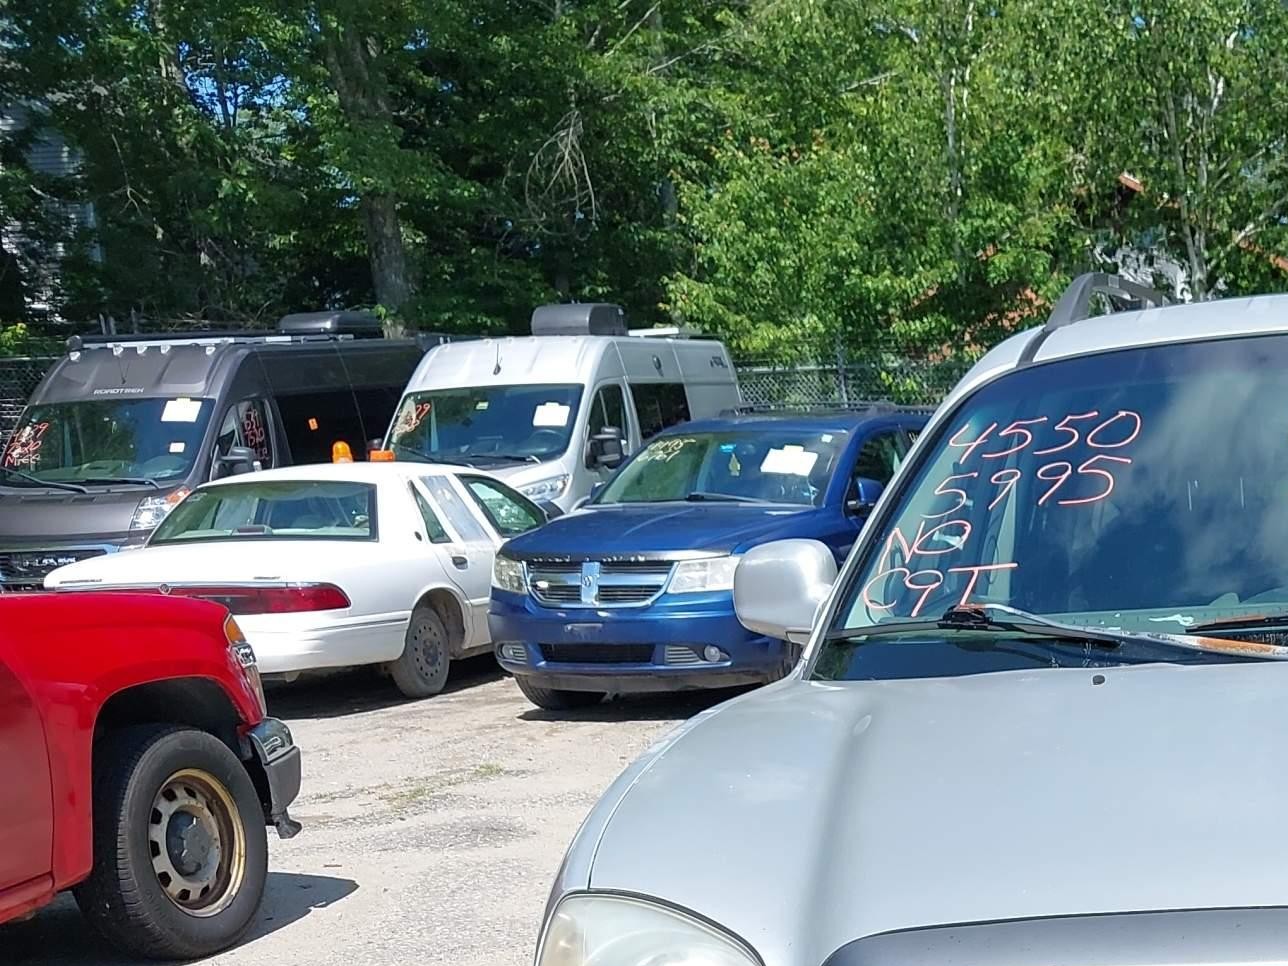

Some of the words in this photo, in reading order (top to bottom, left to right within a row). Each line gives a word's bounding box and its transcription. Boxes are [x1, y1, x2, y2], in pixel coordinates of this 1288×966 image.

[949, 410, 1142, 465] 4550
[919, 455, 1132, 518] 5995
[877, 519, 972, 575] NO
